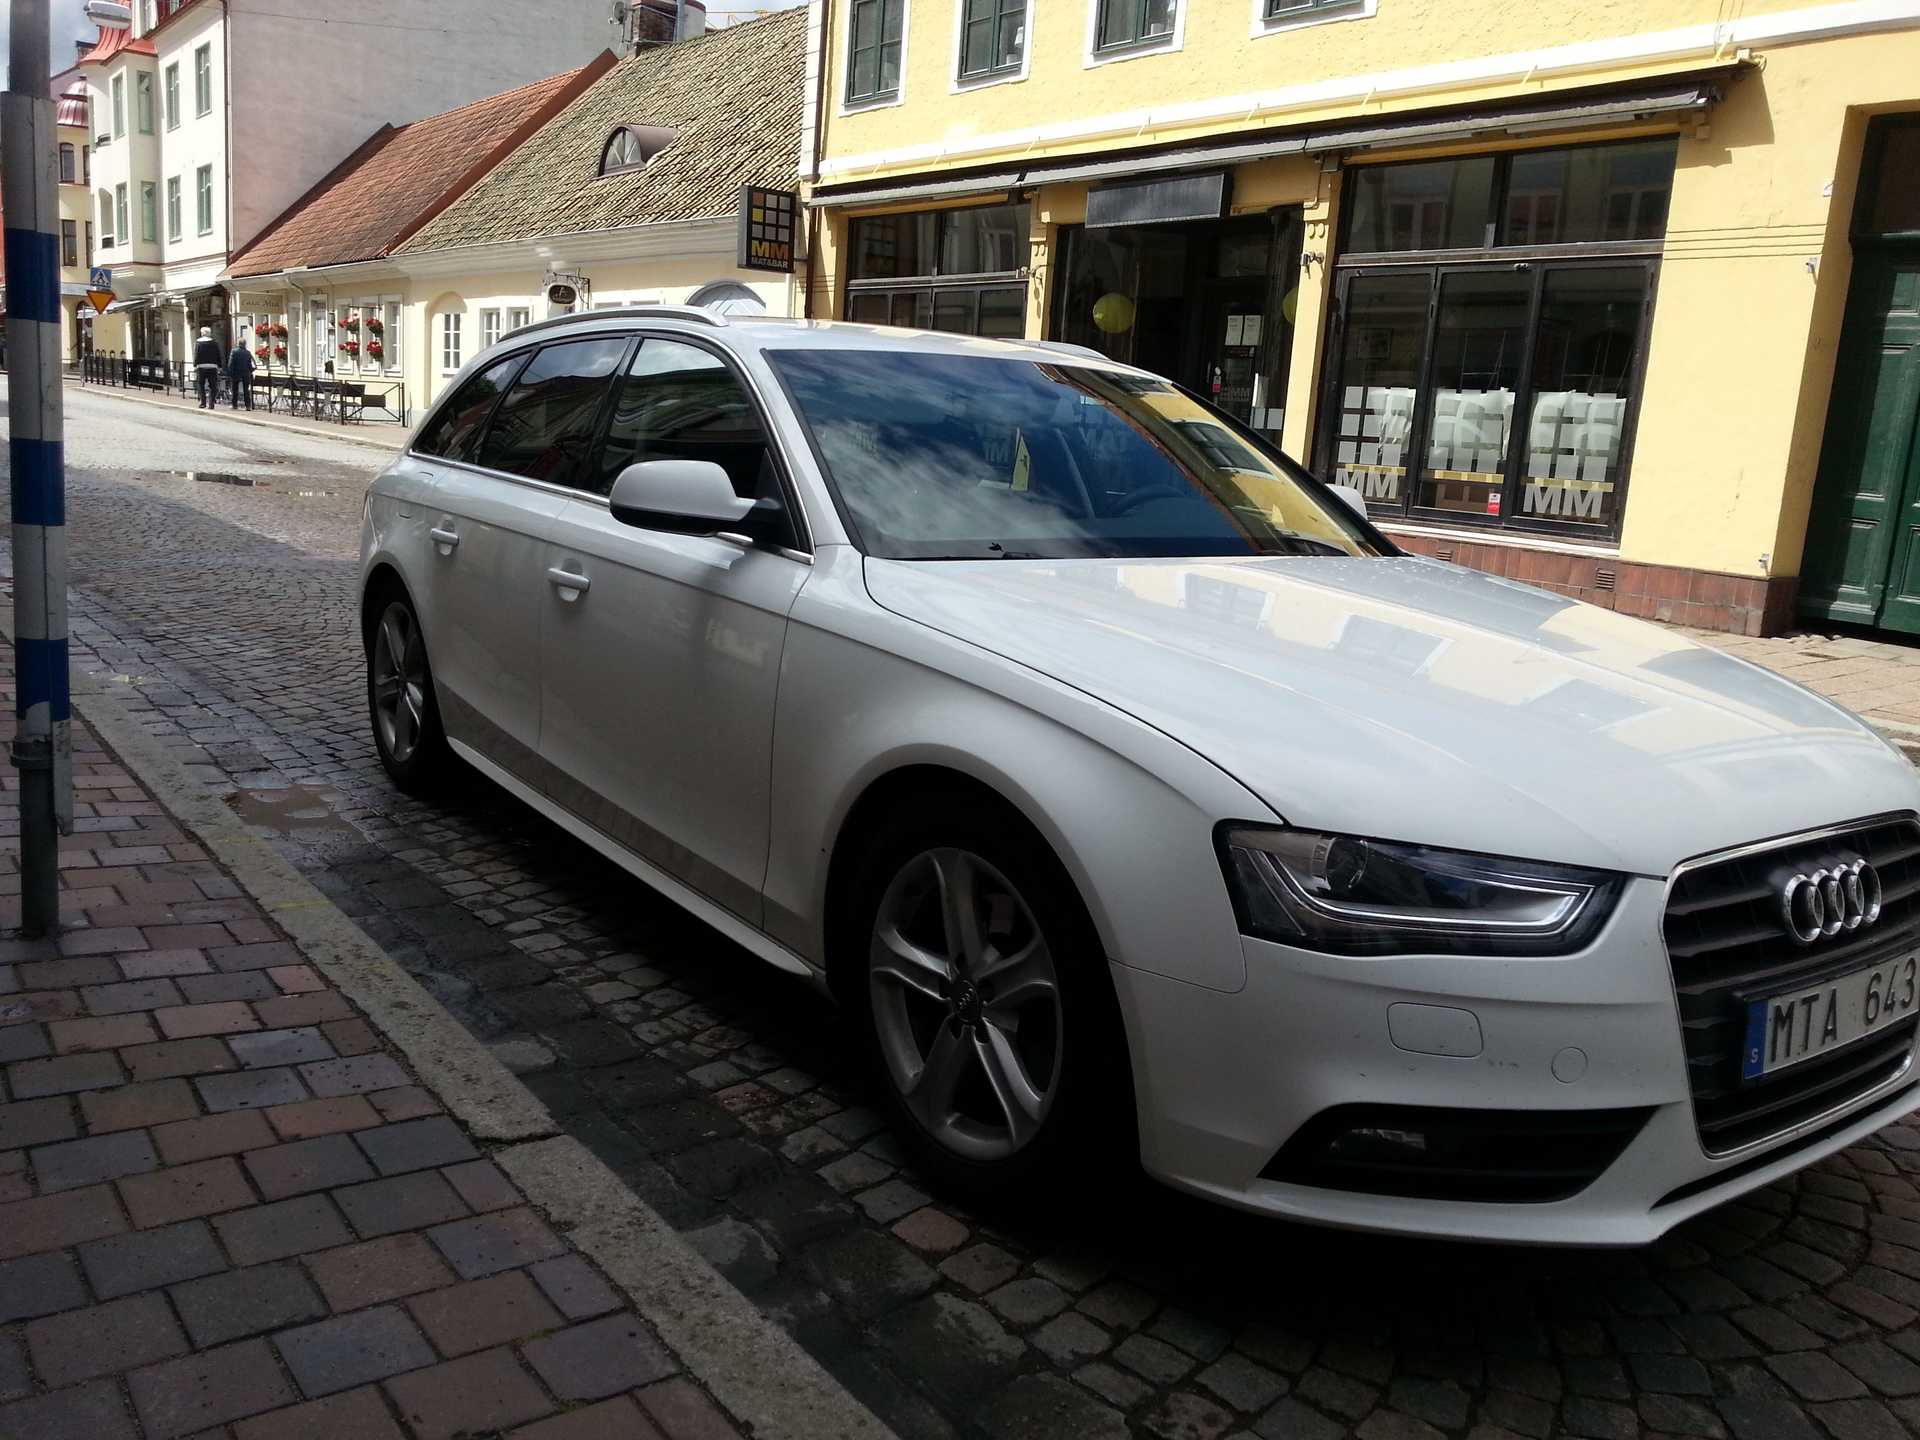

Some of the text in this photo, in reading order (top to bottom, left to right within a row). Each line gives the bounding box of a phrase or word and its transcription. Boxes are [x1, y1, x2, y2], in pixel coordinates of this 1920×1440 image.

[752, 240, 789, 259] MM
[1335, 468, 1399, 499] MM
[1523, 484, 1606, 519] MM
[1771, 957, 1917, 1062] MTA 643
[1750, 1047, 1760, 1064] S
